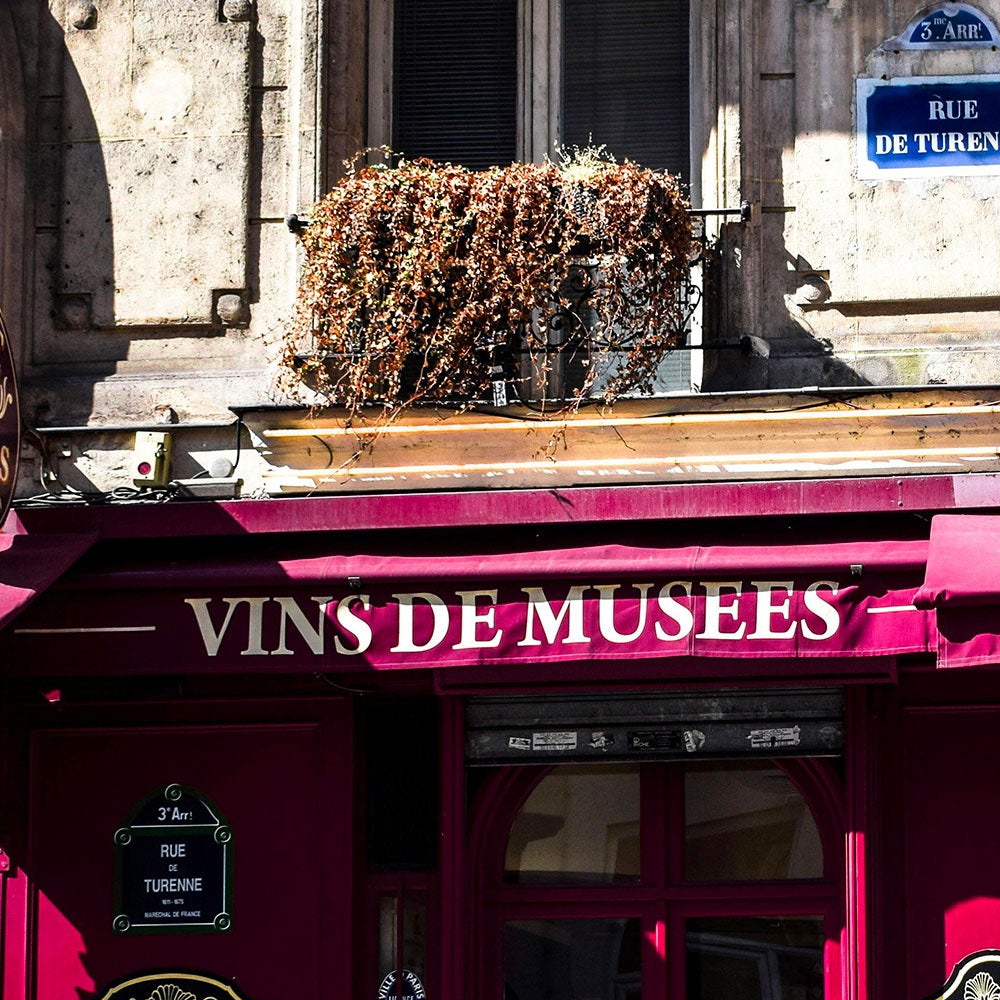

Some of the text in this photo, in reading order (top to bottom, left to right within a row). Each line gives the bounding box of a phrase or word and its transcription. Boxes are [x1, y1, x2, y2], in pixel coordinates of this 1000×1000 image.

[929, 100, 978, 120] RUE
[876, 134, 908, 154] DE
[184, 581, 843, 657] VINS DE MUSEES
[160, 844, 186, 858] RUE
[168, 864, 178, 872] DE
[144, 878, 202, 892] TURENNE
[378, 972, 425, 1000] VILLE PARIS
